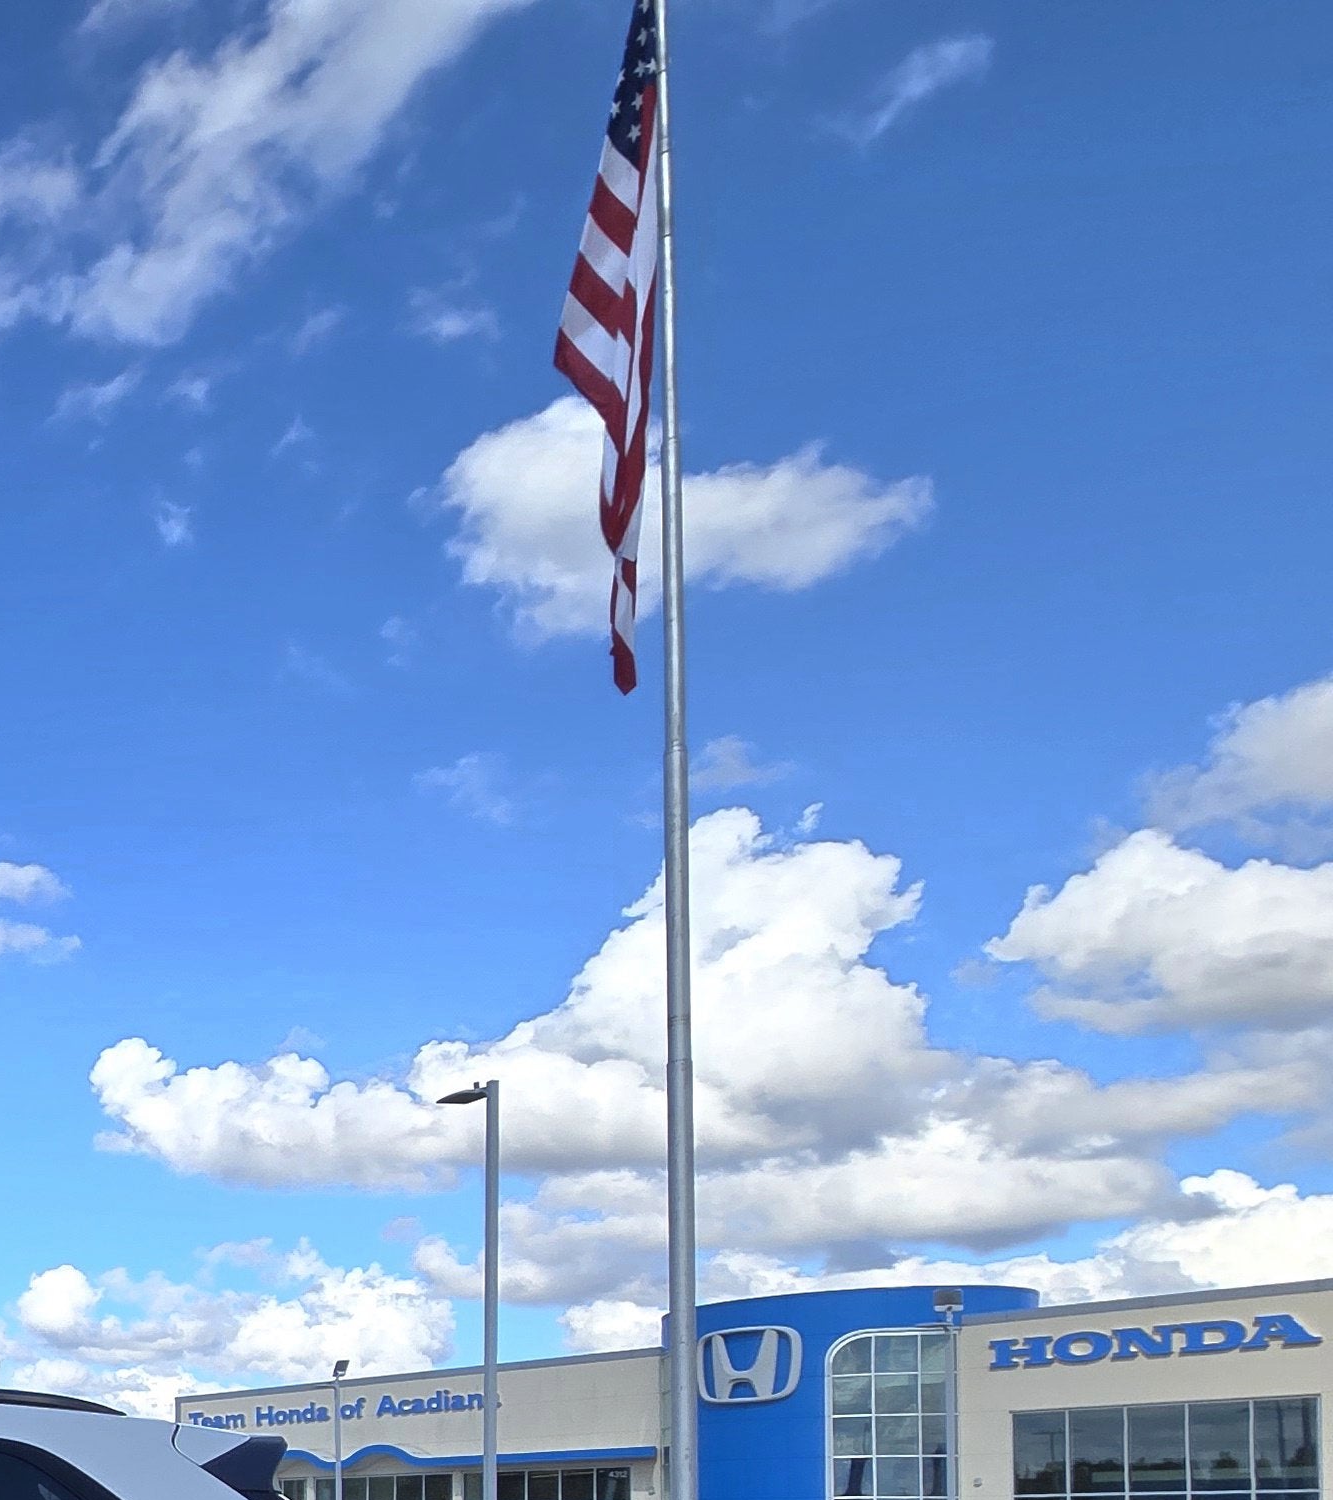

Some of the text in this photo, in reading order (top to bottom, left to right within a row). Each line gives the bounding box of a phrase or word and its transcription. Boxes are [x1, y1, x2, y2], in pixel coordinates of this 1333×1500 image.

[989, 1313, 1323, 1371] HONDA
[188, 1411, 246, 1429] Team
[256, 1402, 331, 1427] Honda
[340, 1397, 366, 1419] of
